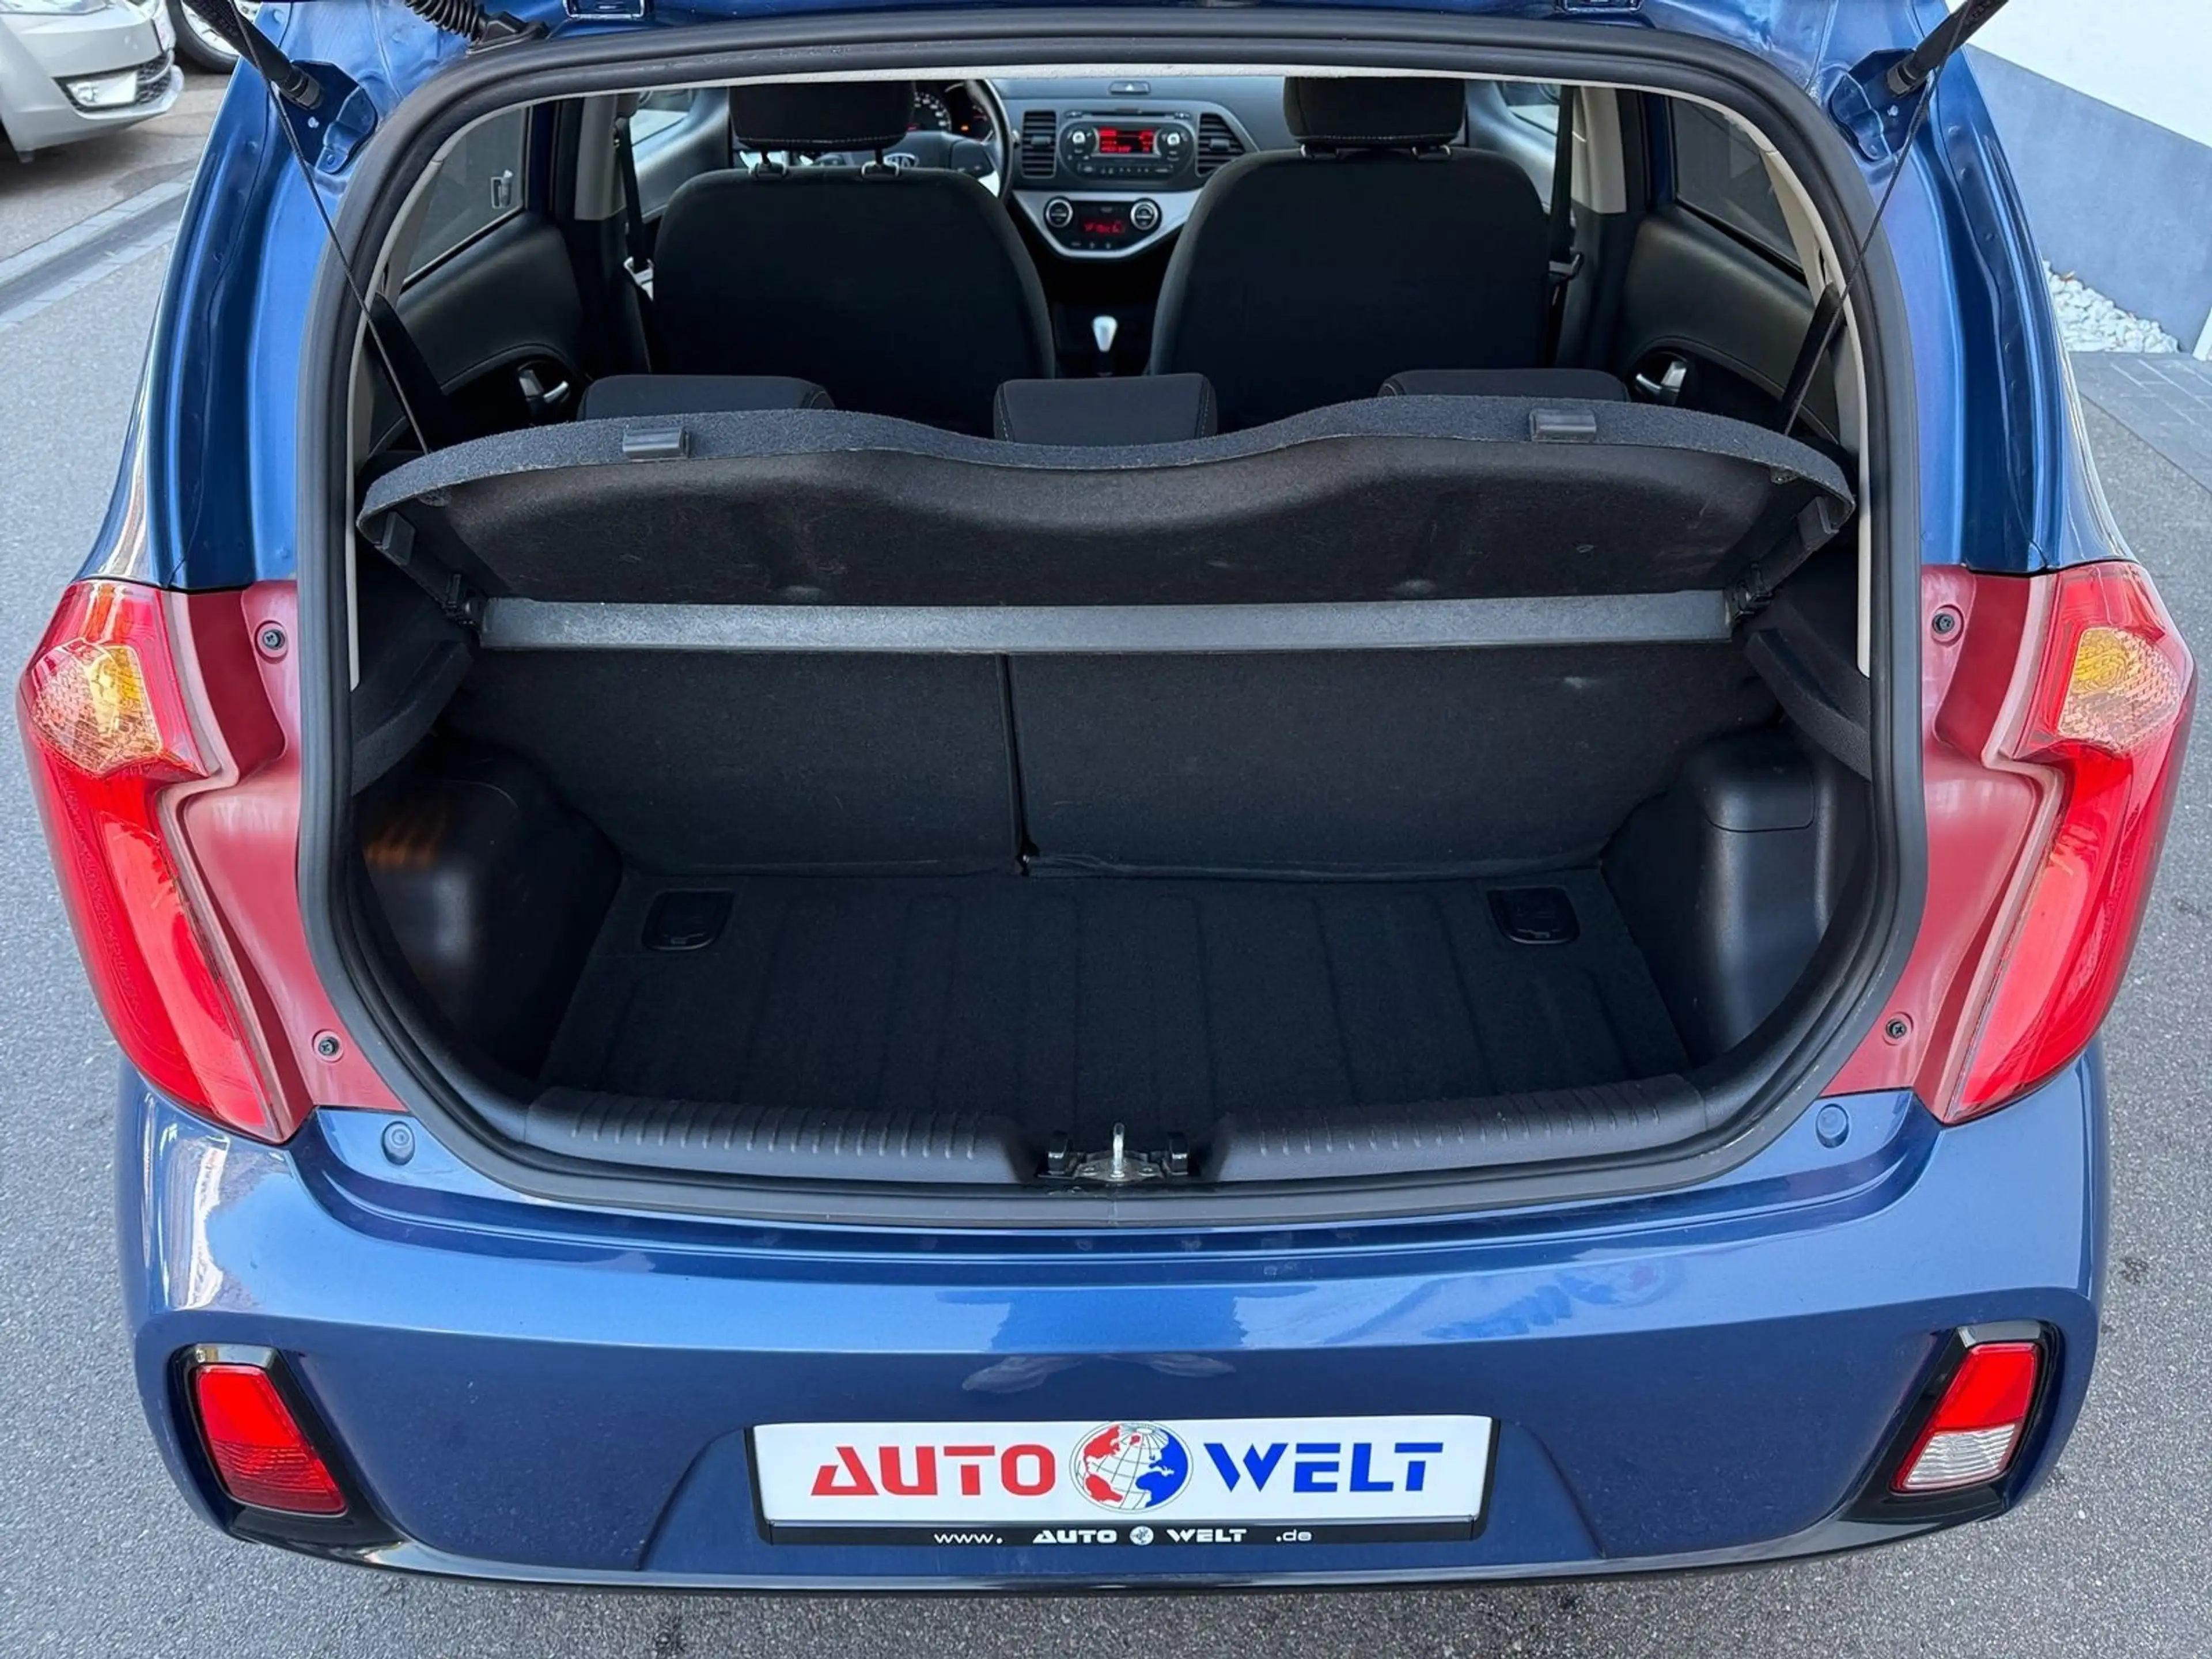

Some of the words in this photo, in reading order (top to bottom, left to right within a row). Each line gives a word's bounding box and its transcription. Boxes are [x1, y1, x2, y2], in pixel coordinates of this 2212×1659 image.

[811, 1445, 1056, 1496] AUTO
[1203, 1441, 1445, 1494] WELT
[933, 1533, 1003, 1544] www.
[1032, 1529, 1118, 1544] AUTO
[1166, 1528, 1248, 1543] WELT
[1275, 1528, 1313, 1543] .de
